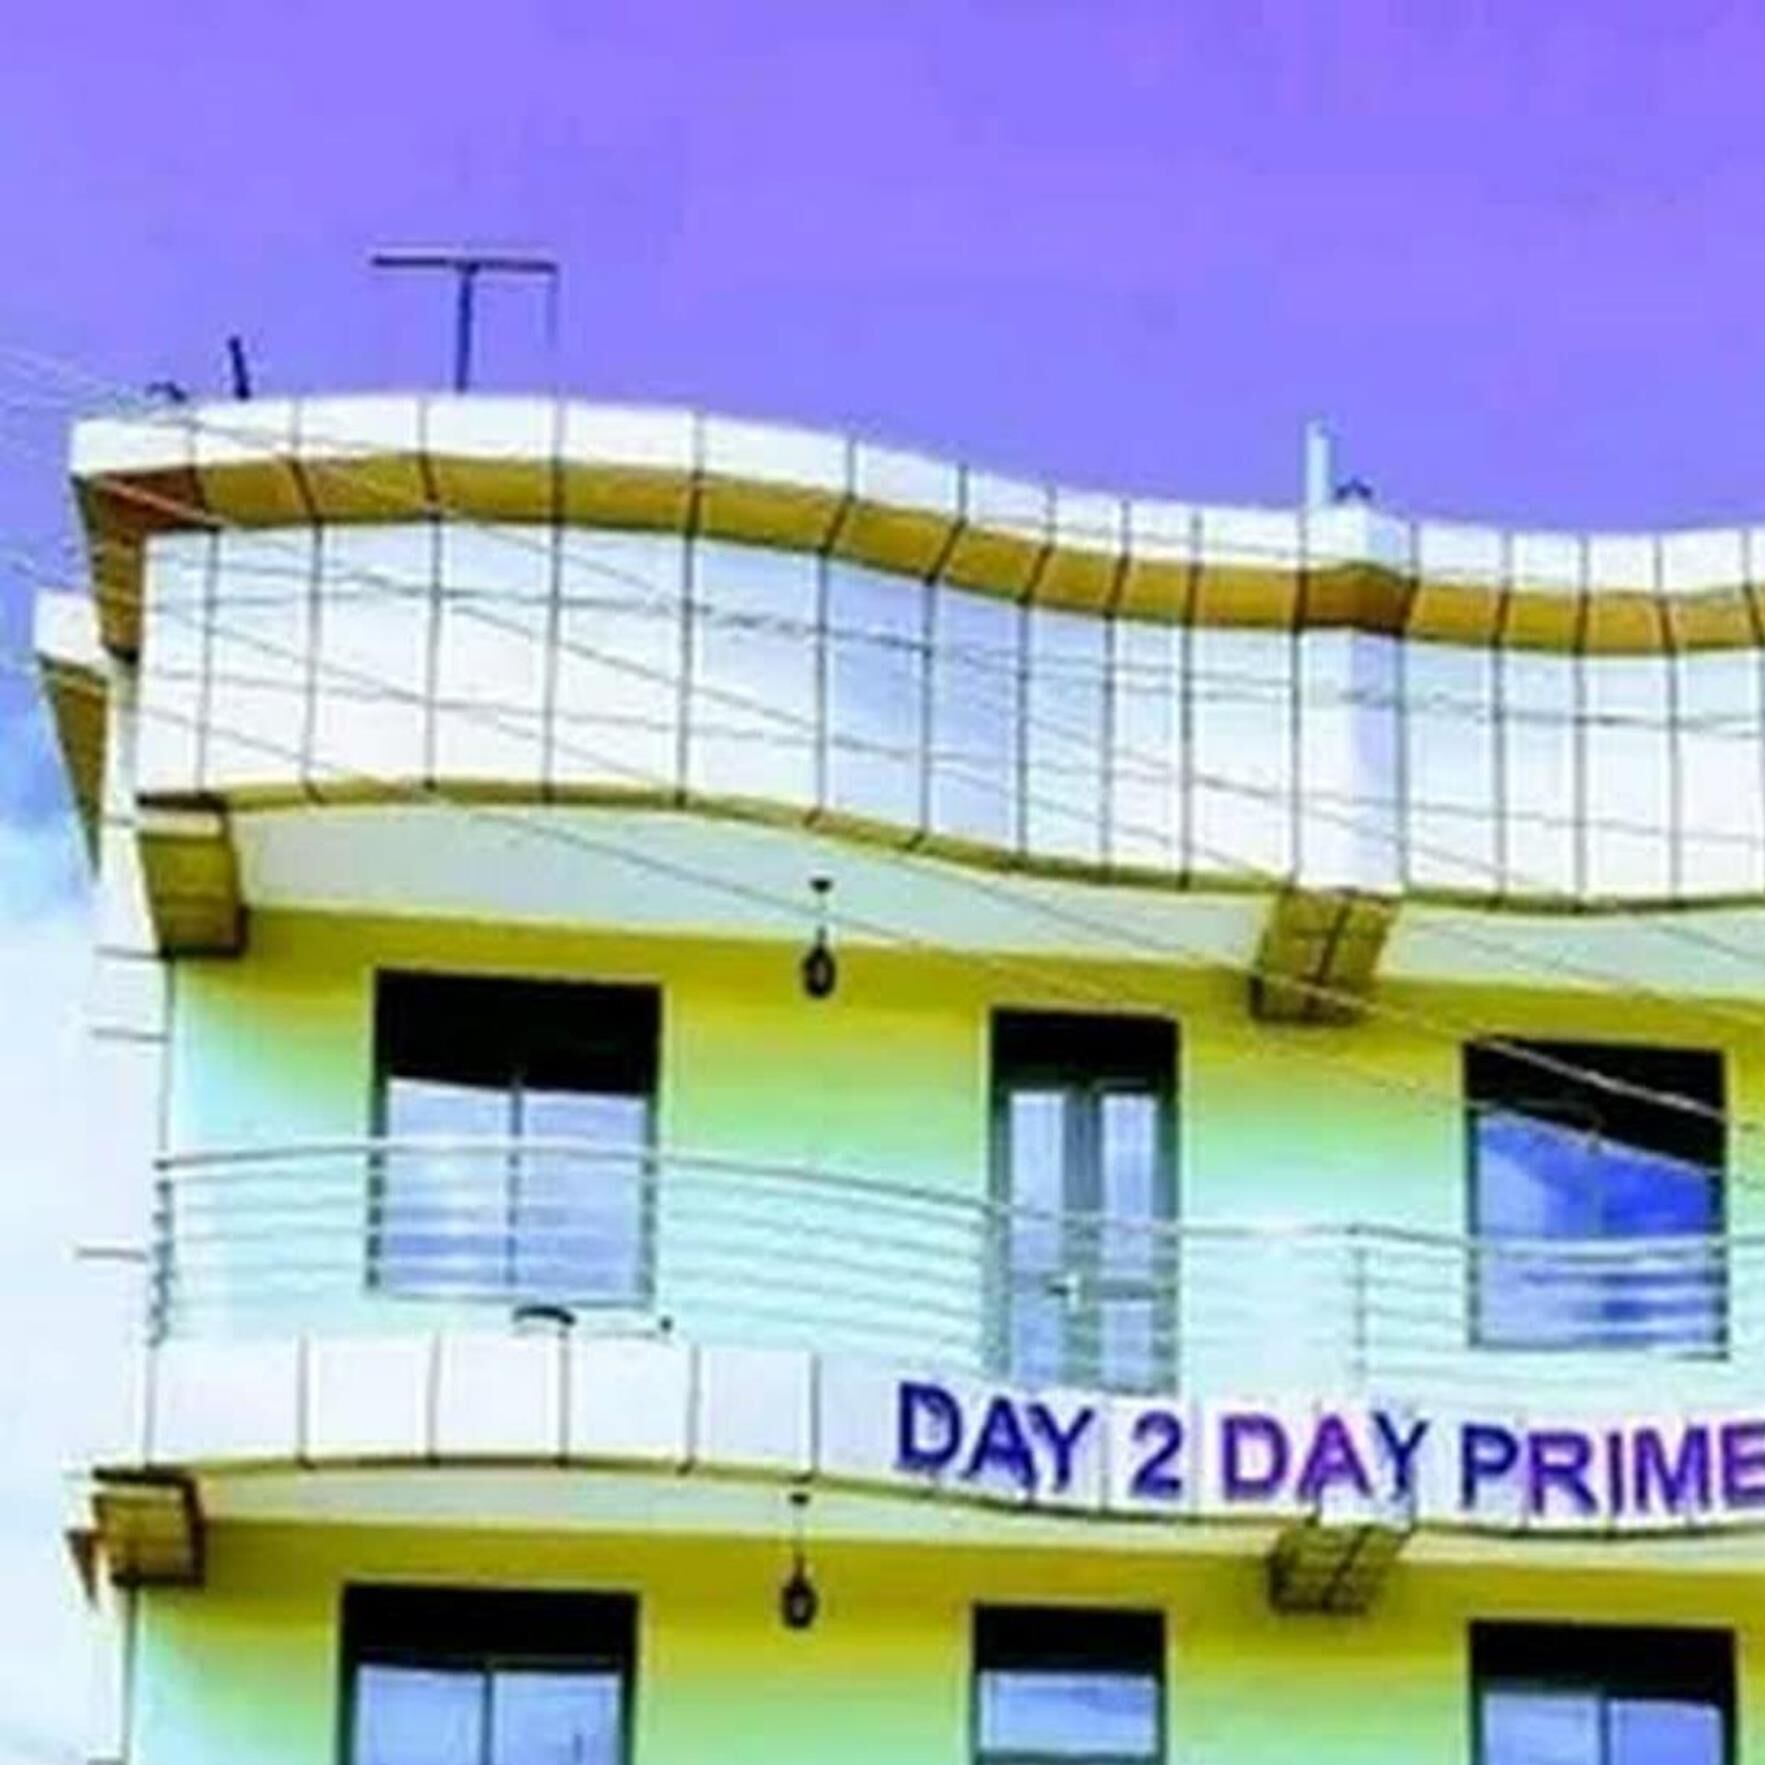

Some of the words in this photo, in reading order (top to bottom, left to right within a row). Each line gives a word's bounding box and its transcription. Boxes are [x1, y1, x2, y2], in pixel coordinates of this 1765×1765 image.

[898, 1382, 1093, 1494] DAY
[1131, 1411, 1184, 1499] 2
[1221, 1412, 1429, 1502] DAY
